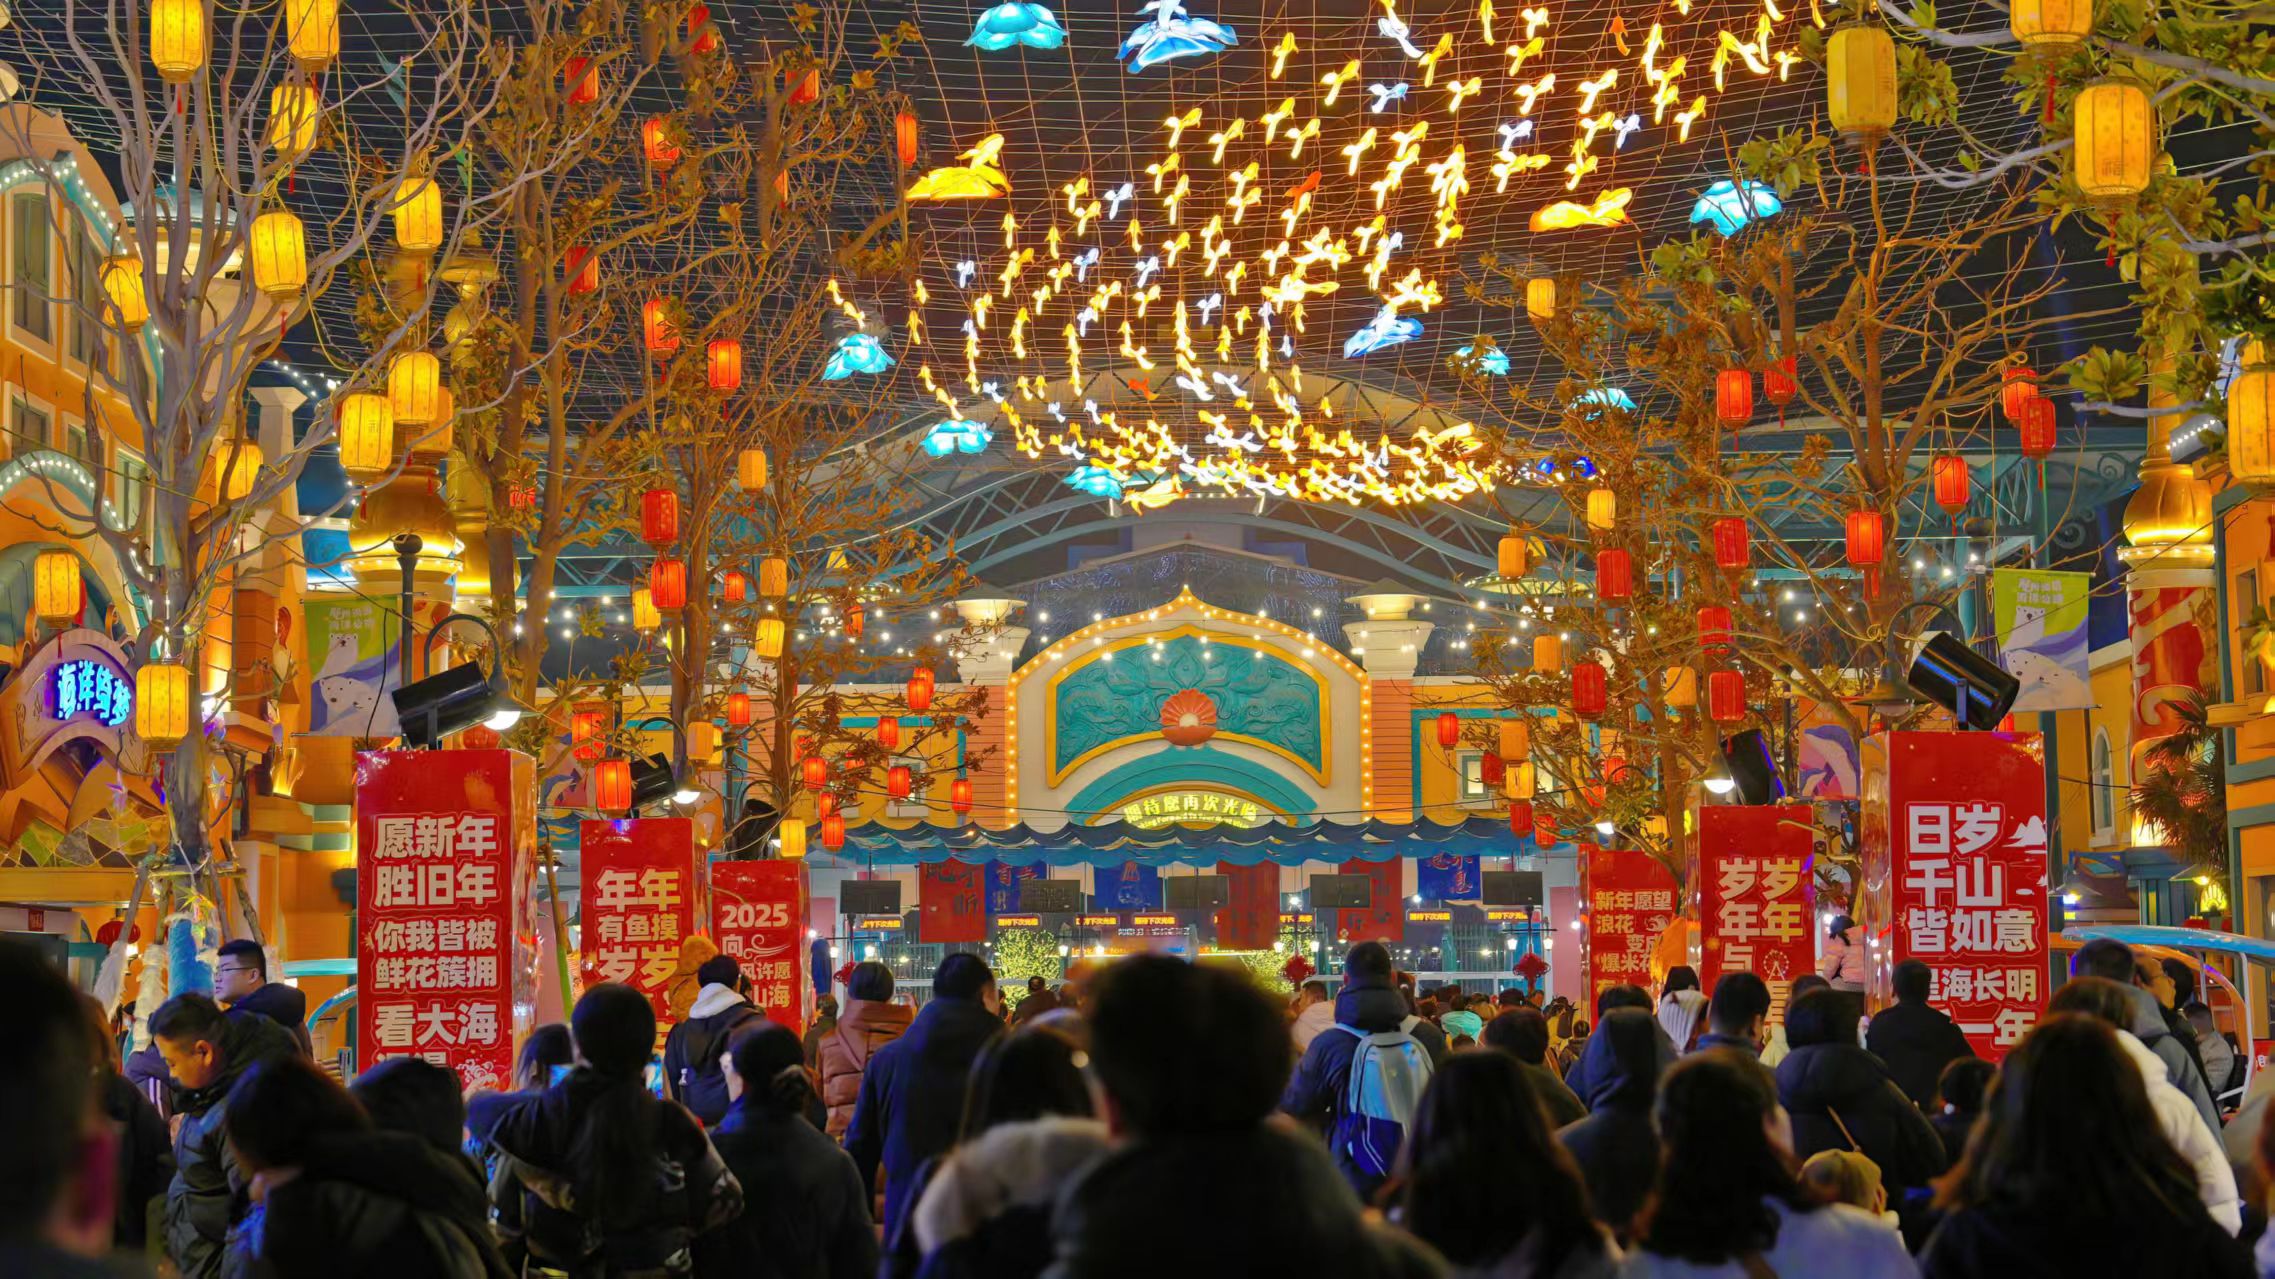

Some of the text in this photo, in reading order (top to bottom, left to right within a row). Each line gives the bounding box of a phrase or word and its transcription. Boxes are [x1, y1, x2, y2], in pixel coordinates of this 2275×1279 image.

[1124, 794, 1258, 824] 期待您再次光临
[1909, 804, 2001, 855] 日岁
[375, 815, 497, 859] 愿新年
[375, 863, 497, 907] 胜旧年
[596, 868, 681, 912] 年年
[1718, 857, 1801, 900] 岁岁
[1906, 857, 2003, 907] 千山
[721, 903, 789, 929] 2025
[1595, 890, 1673, 911] 新年愿望
[375, 919, 497, 953] 你我皆被
[598, 913, 680, 943] 有鱼摸
[1596, 914, 1635, 934] 浪花
[1718, 901, 1804, 943] 年年
[1908, 908, 2036, 953] 皆如意
[599, 944, 680, 989] 岁岁
[722, 934, 744, 957] 向
[375, 956, 497, 989] 鲜花簇拥
[376, 1003, 498, 1047] 看大海
